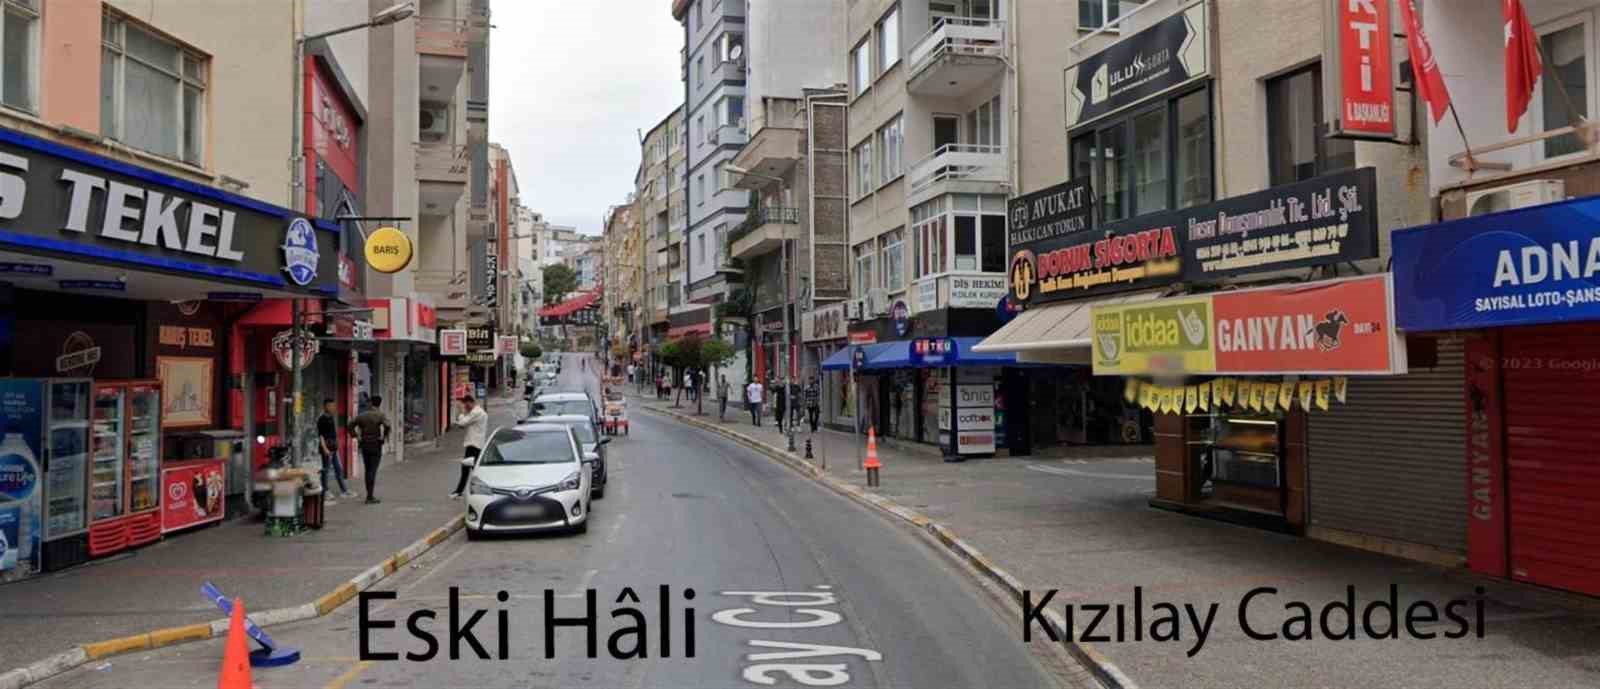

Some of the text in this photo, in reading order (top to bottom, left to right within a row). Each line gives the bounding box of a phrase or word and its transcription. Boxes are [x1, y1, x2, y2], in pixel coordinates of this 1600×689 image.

[60, 169, 243, 262] TEKEL
[1032, 186, 1084, 220] AVUKAT
[1055, 215, 1085, 235] TORUN
[1095, 226, 1176, 269] SİGORTA
[1492, 237, 1600, 289] ADNA
[1475, 295, 1526, 312] SAYISAL
[1126, 310, 1179, 348] iddaa
[1218, 313, 1316, 352] GANYAN
